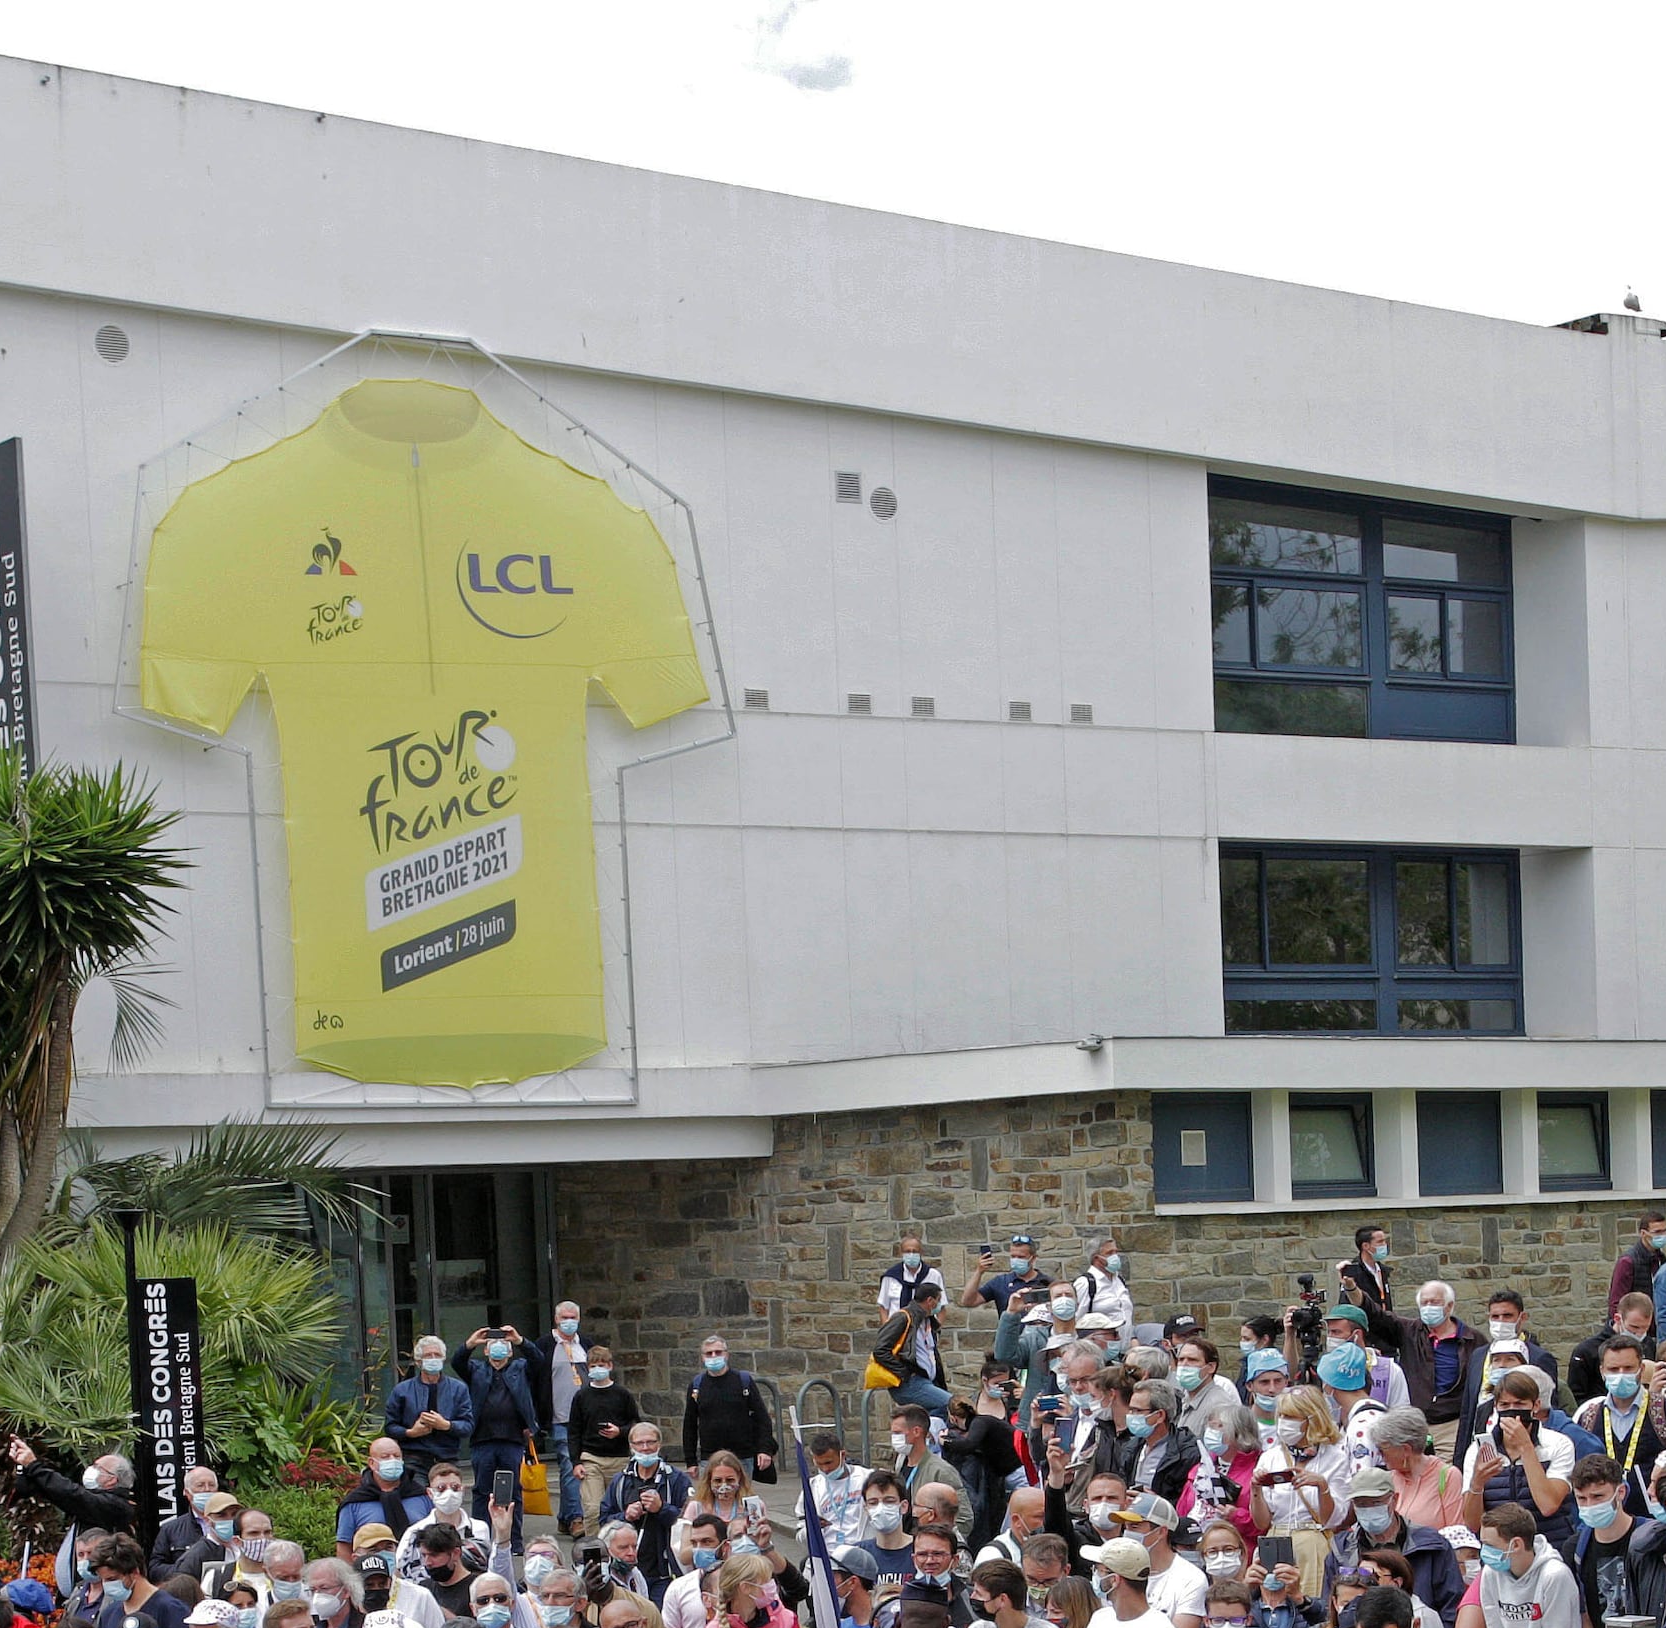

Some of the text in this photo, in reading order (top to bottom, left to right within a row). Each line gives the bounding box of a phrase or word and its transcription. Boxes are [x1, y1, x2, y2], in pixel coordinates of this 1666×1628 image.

[1, 551, 17, 606] Sud
[467, 553, 574, 595] LCL
[7, 616, 25, 744] Bretagne
[366, 710, 497, 797] TOUR
[458, 761, 480, 785] de
[359, 774, 518, 855] france
[380, 827, 507, 894] GRAND DÉPART
[382, 851, 508, 918] BRETAGNE 2021
[394, 916, 505, 975] Lorient 28 juin
[174, 1332, 197, 1436] Bretagne Sud
[153, 1408, 174, 1456] DES
